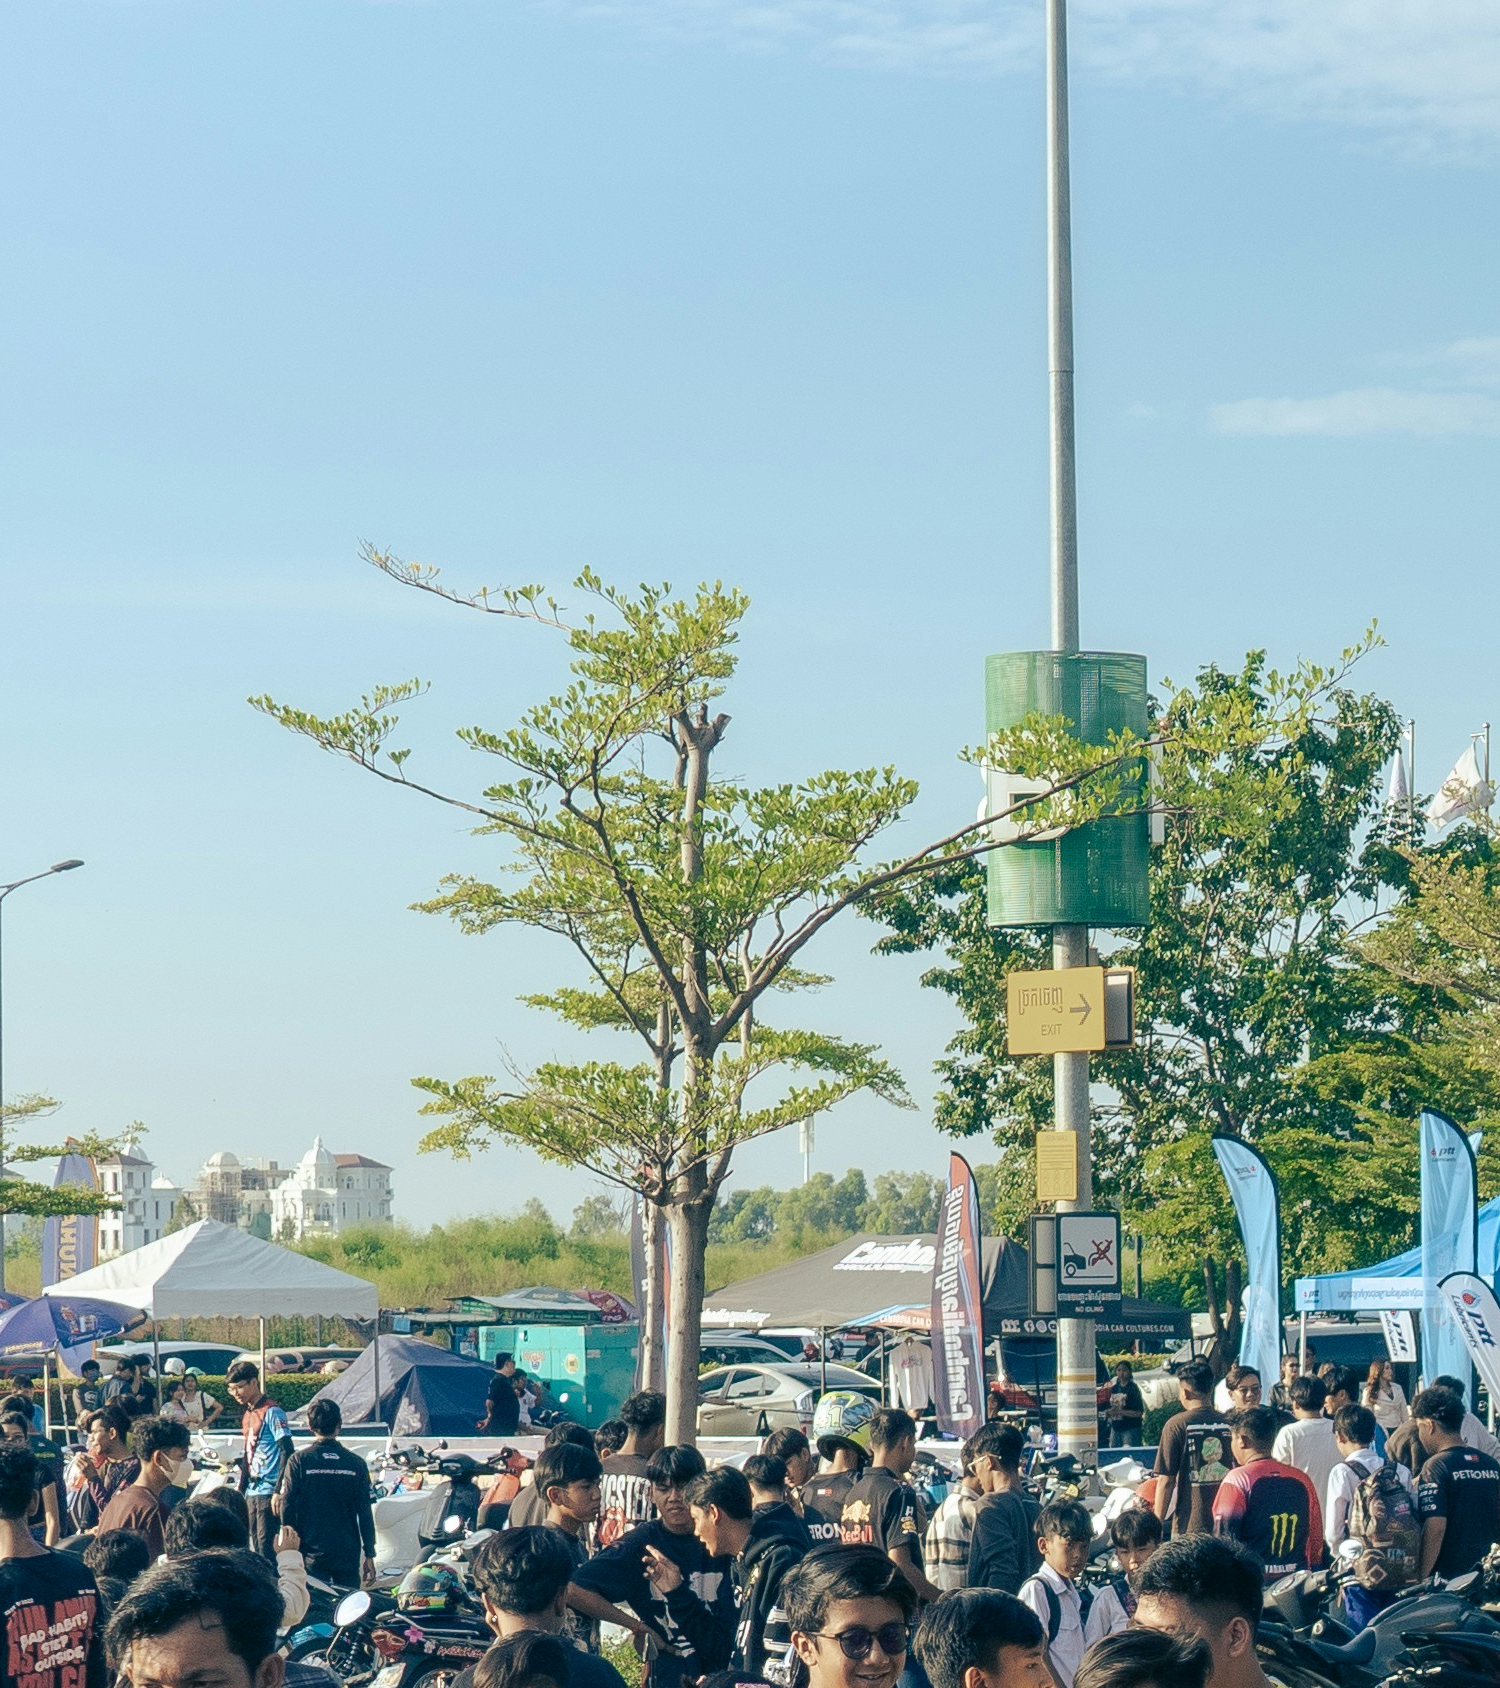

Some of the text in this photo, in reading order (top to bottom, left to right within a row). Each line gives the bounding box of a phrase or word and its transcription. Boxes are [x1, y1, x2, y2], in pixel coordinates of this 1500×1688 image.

[1041, 1023, 1063, 1037] EXIT
[1468, 1310, 1498, 1348] ptt
[1452, 1469, 1500, 1481] PETRONAS
[20, 1610, 88, 1654] BAD HABITS
[41, 1634, 69, 1656] STEP
